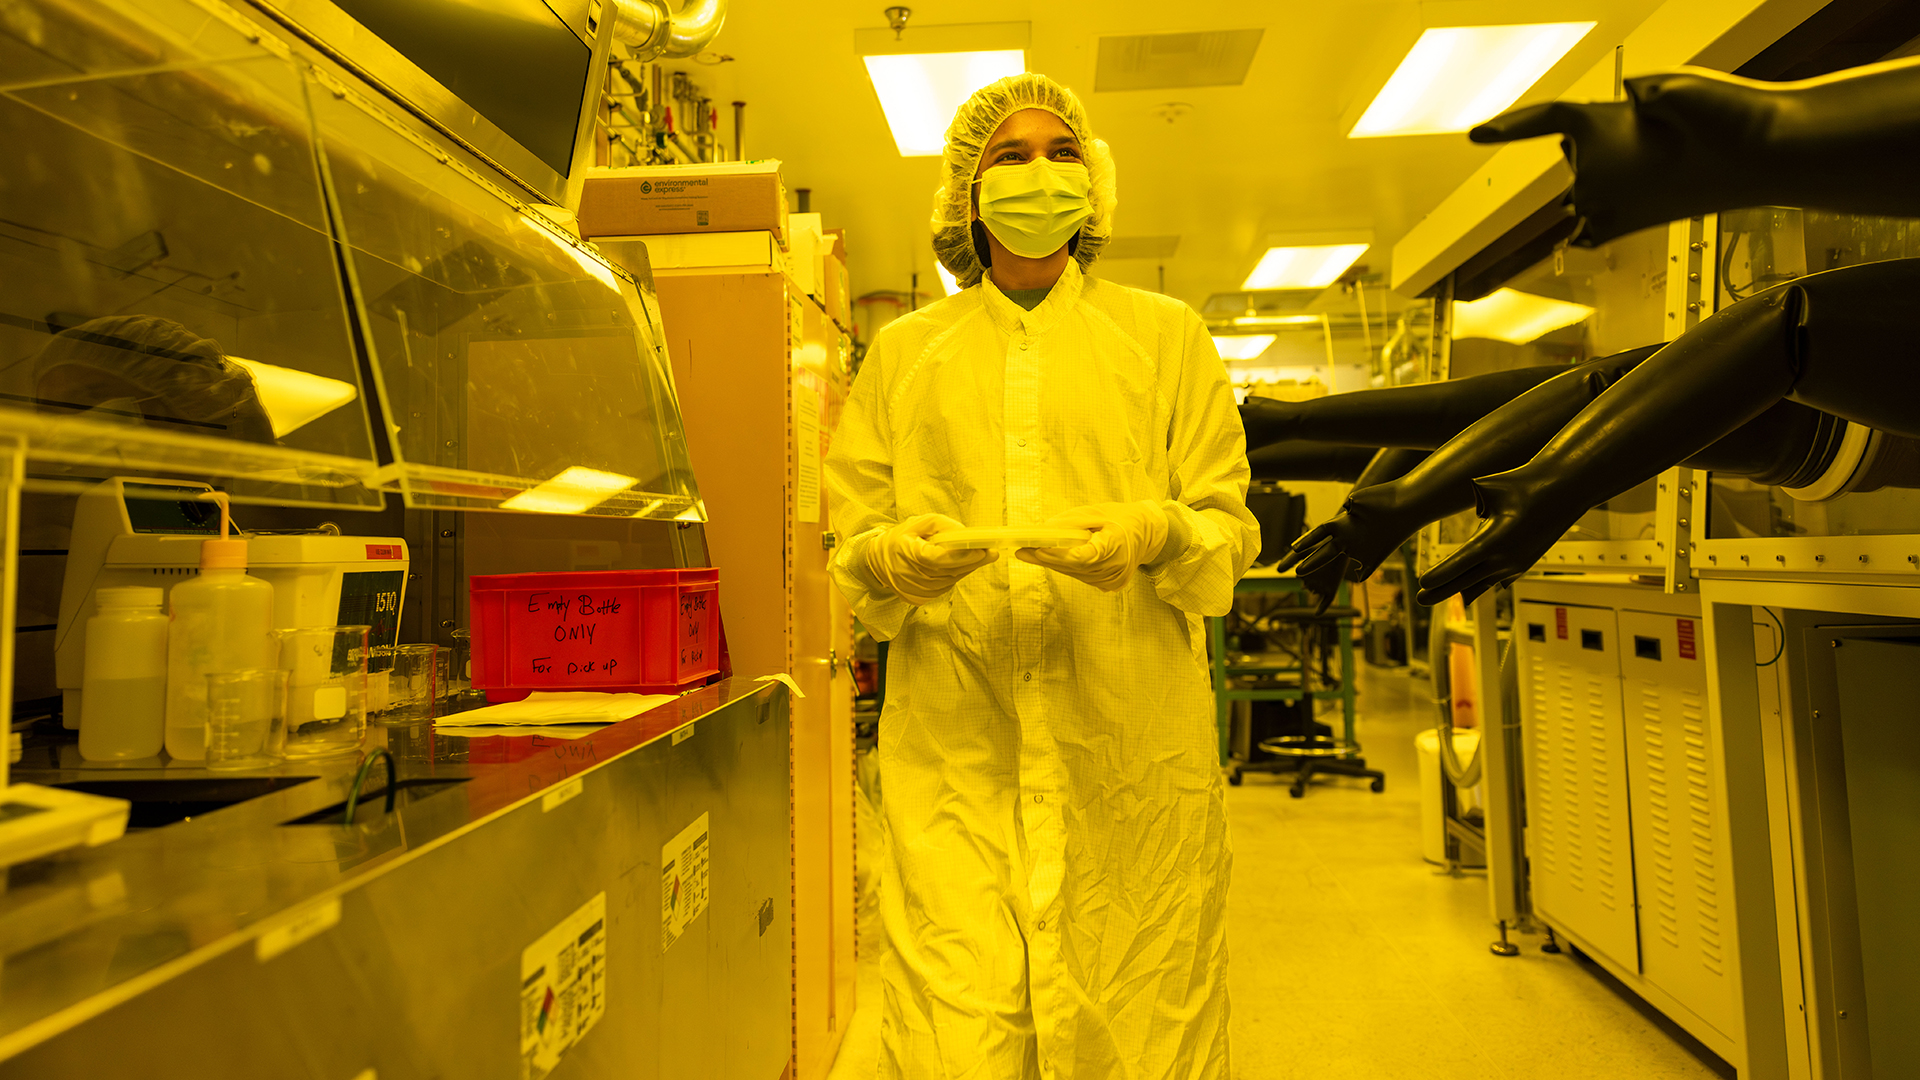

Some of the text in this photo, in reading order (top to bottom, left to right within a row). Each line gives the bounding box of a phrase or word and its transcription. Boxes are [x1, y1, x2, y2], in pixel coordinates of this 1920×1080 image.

[654, 178, 708, 186] environmental
[654, 186, 685, 195] express
[528, 592, 621, 622] Empty Bottle
[532, 656, 552, 673] For
